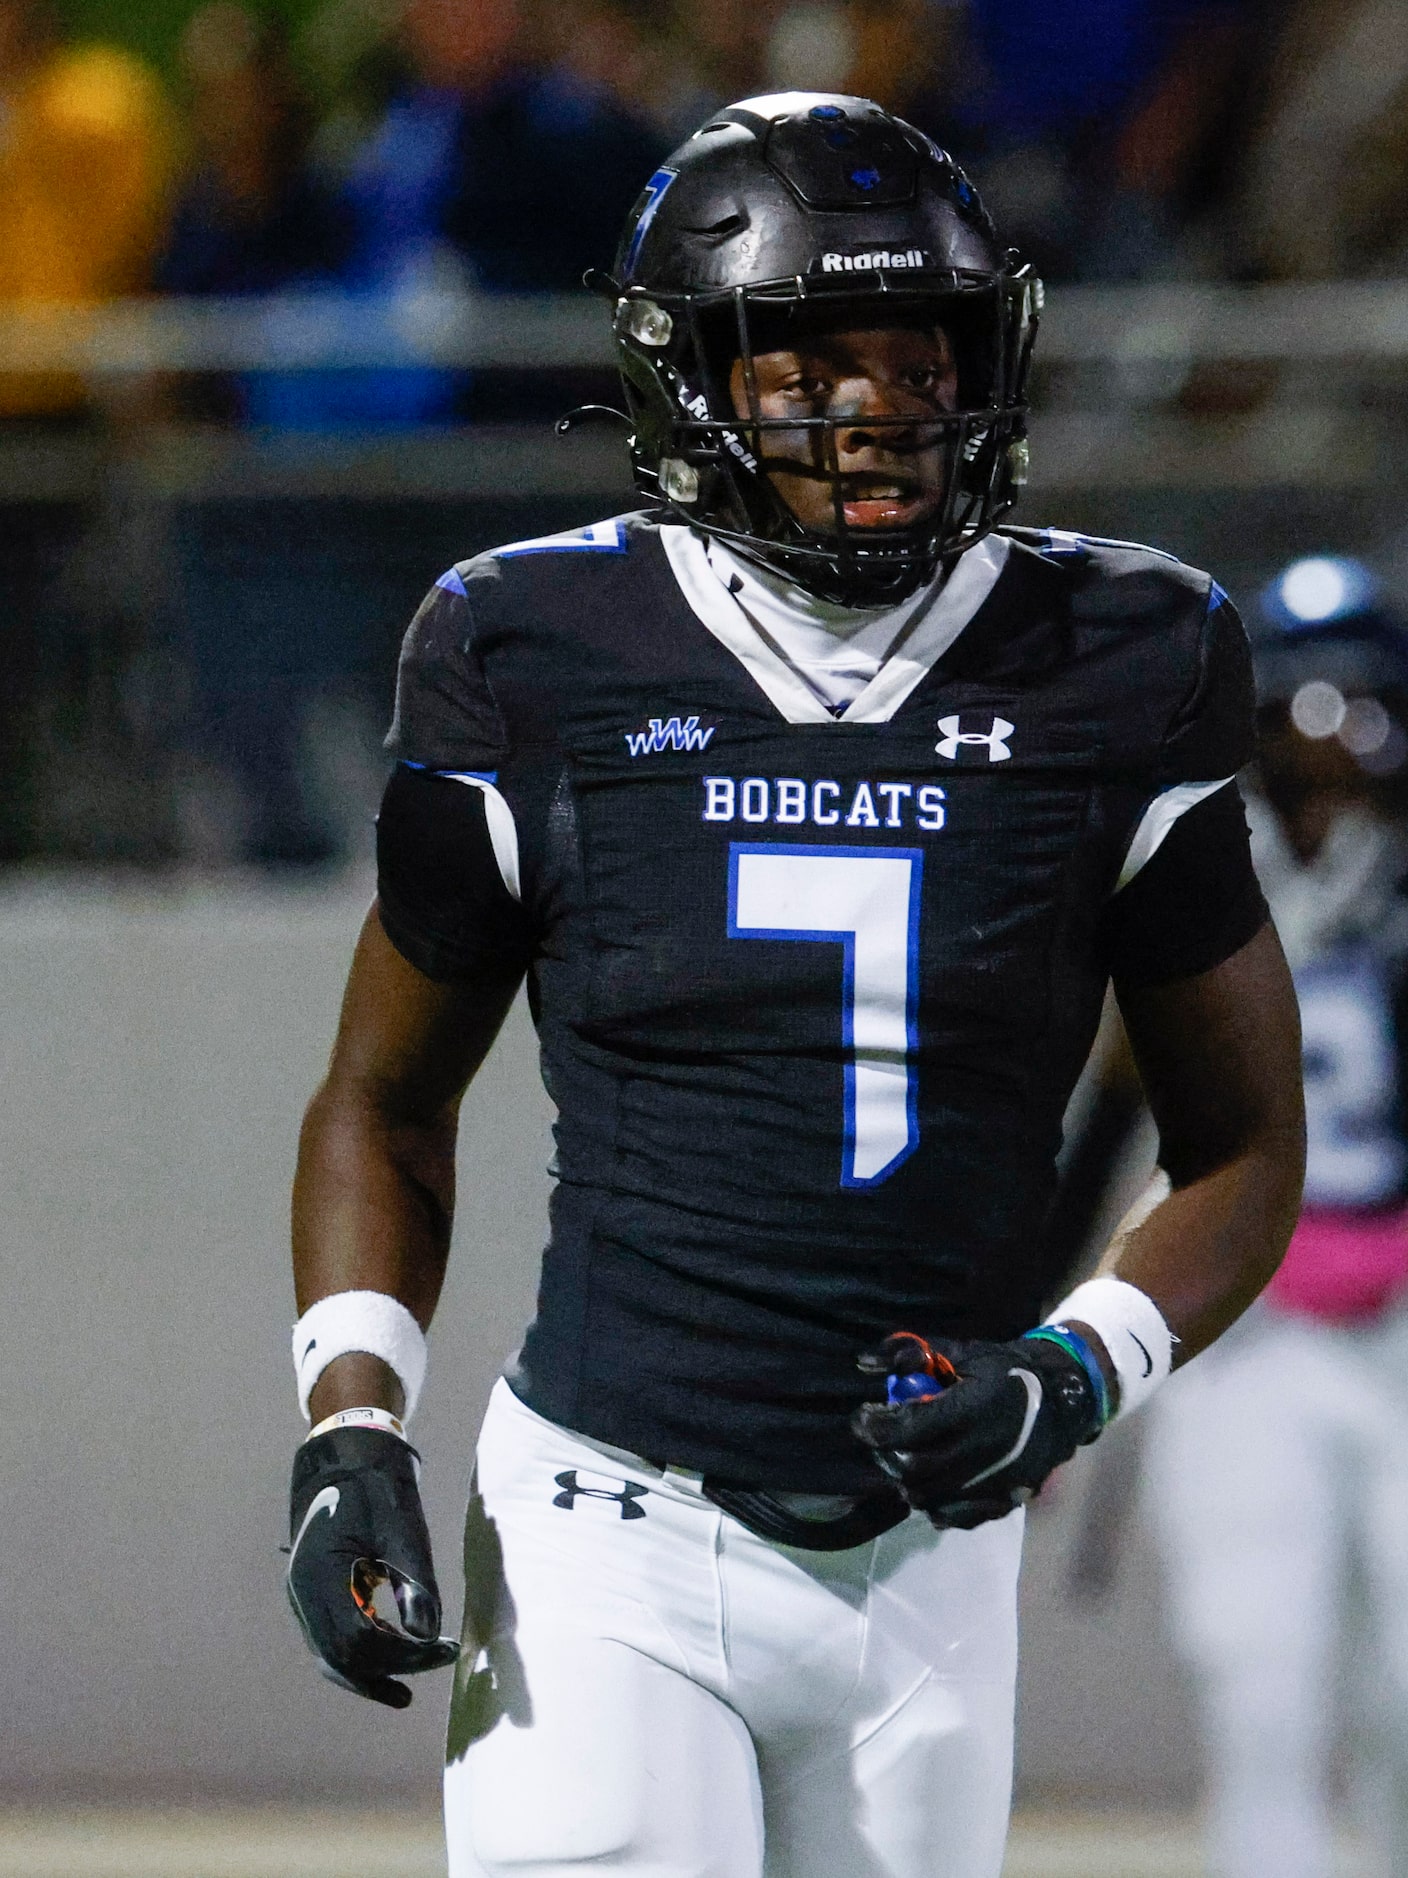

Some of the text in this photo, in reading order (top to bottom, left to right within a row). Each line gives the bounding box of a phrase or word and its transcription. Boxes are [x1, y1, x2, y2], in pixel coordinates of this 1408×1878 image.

[821, 249, 924, 273] Riddell
[702, 775, 948, 831] BOBCATS
[726, 841, 924, 1188] 7
